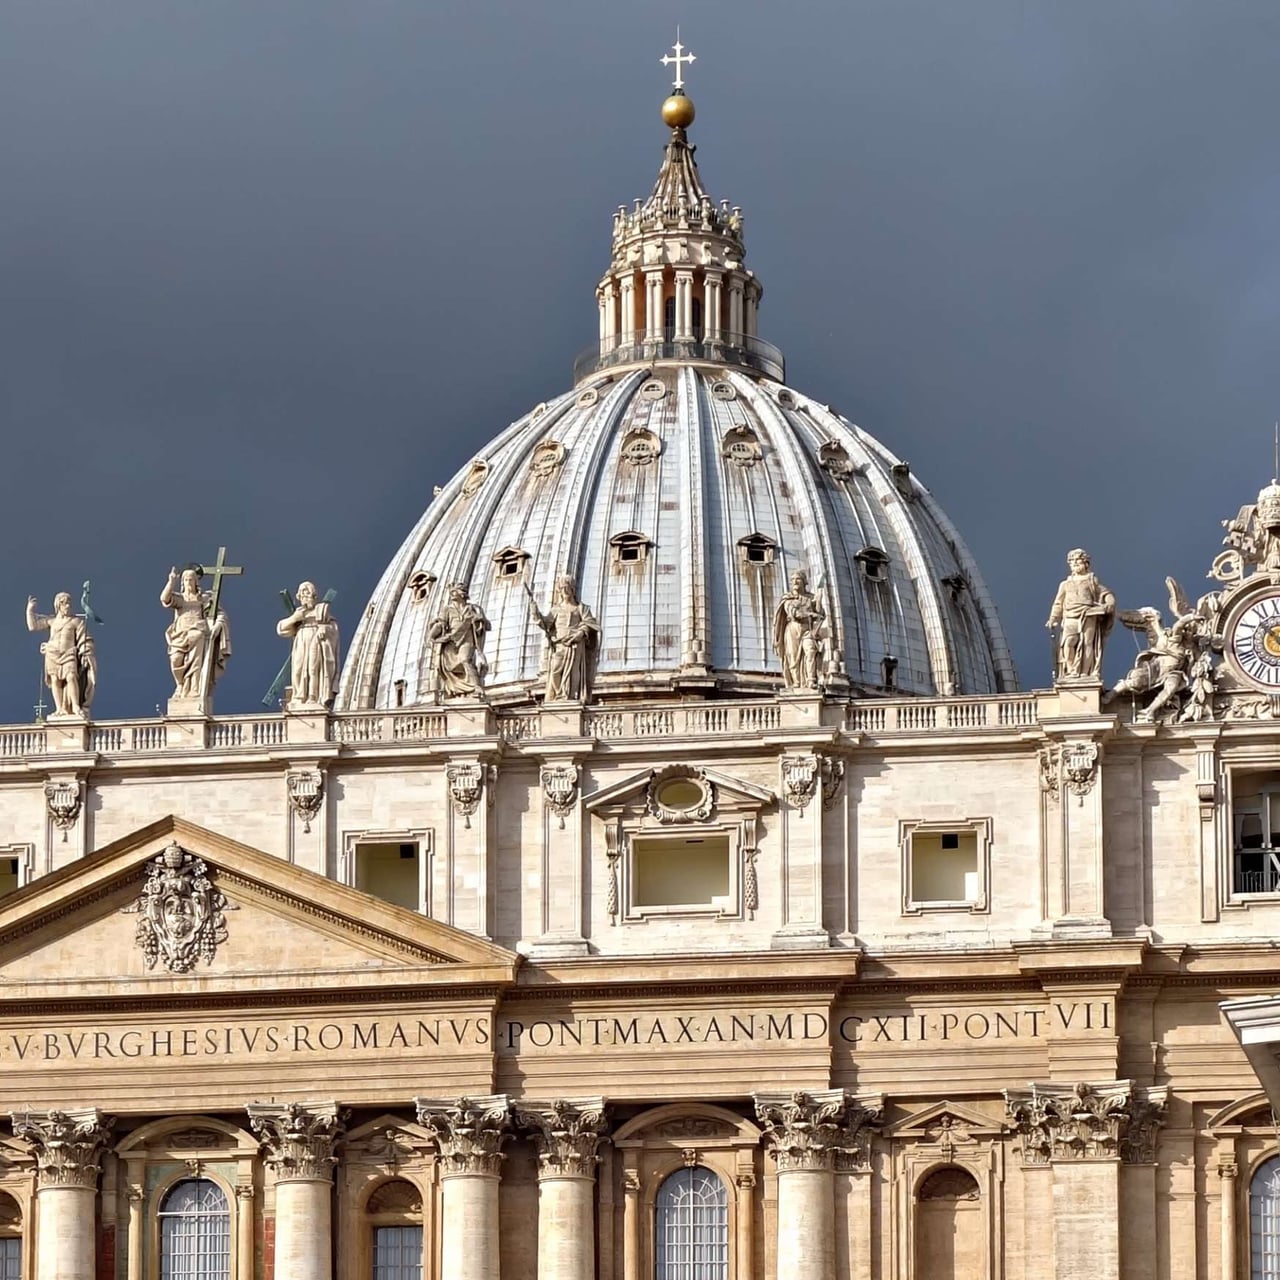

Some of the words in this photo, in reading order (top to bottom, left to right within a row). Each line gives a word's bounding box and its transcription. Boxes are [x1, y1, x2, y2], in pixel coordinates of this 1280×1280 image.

[10, 1033, 34, 1060] V
[43, 1025, 280, 1060] BVRGHESIVS
[293, 1018, 489, 1052] ROMANVS
[505, 1018, 608, 1048] PONT
[610, 1015, 698, 1045] MAX
[703, 1014, 755, 1042] AN
[940, 1010, 1046, 1040] PONT
[1054, 1002, 1112, 1030] VII
